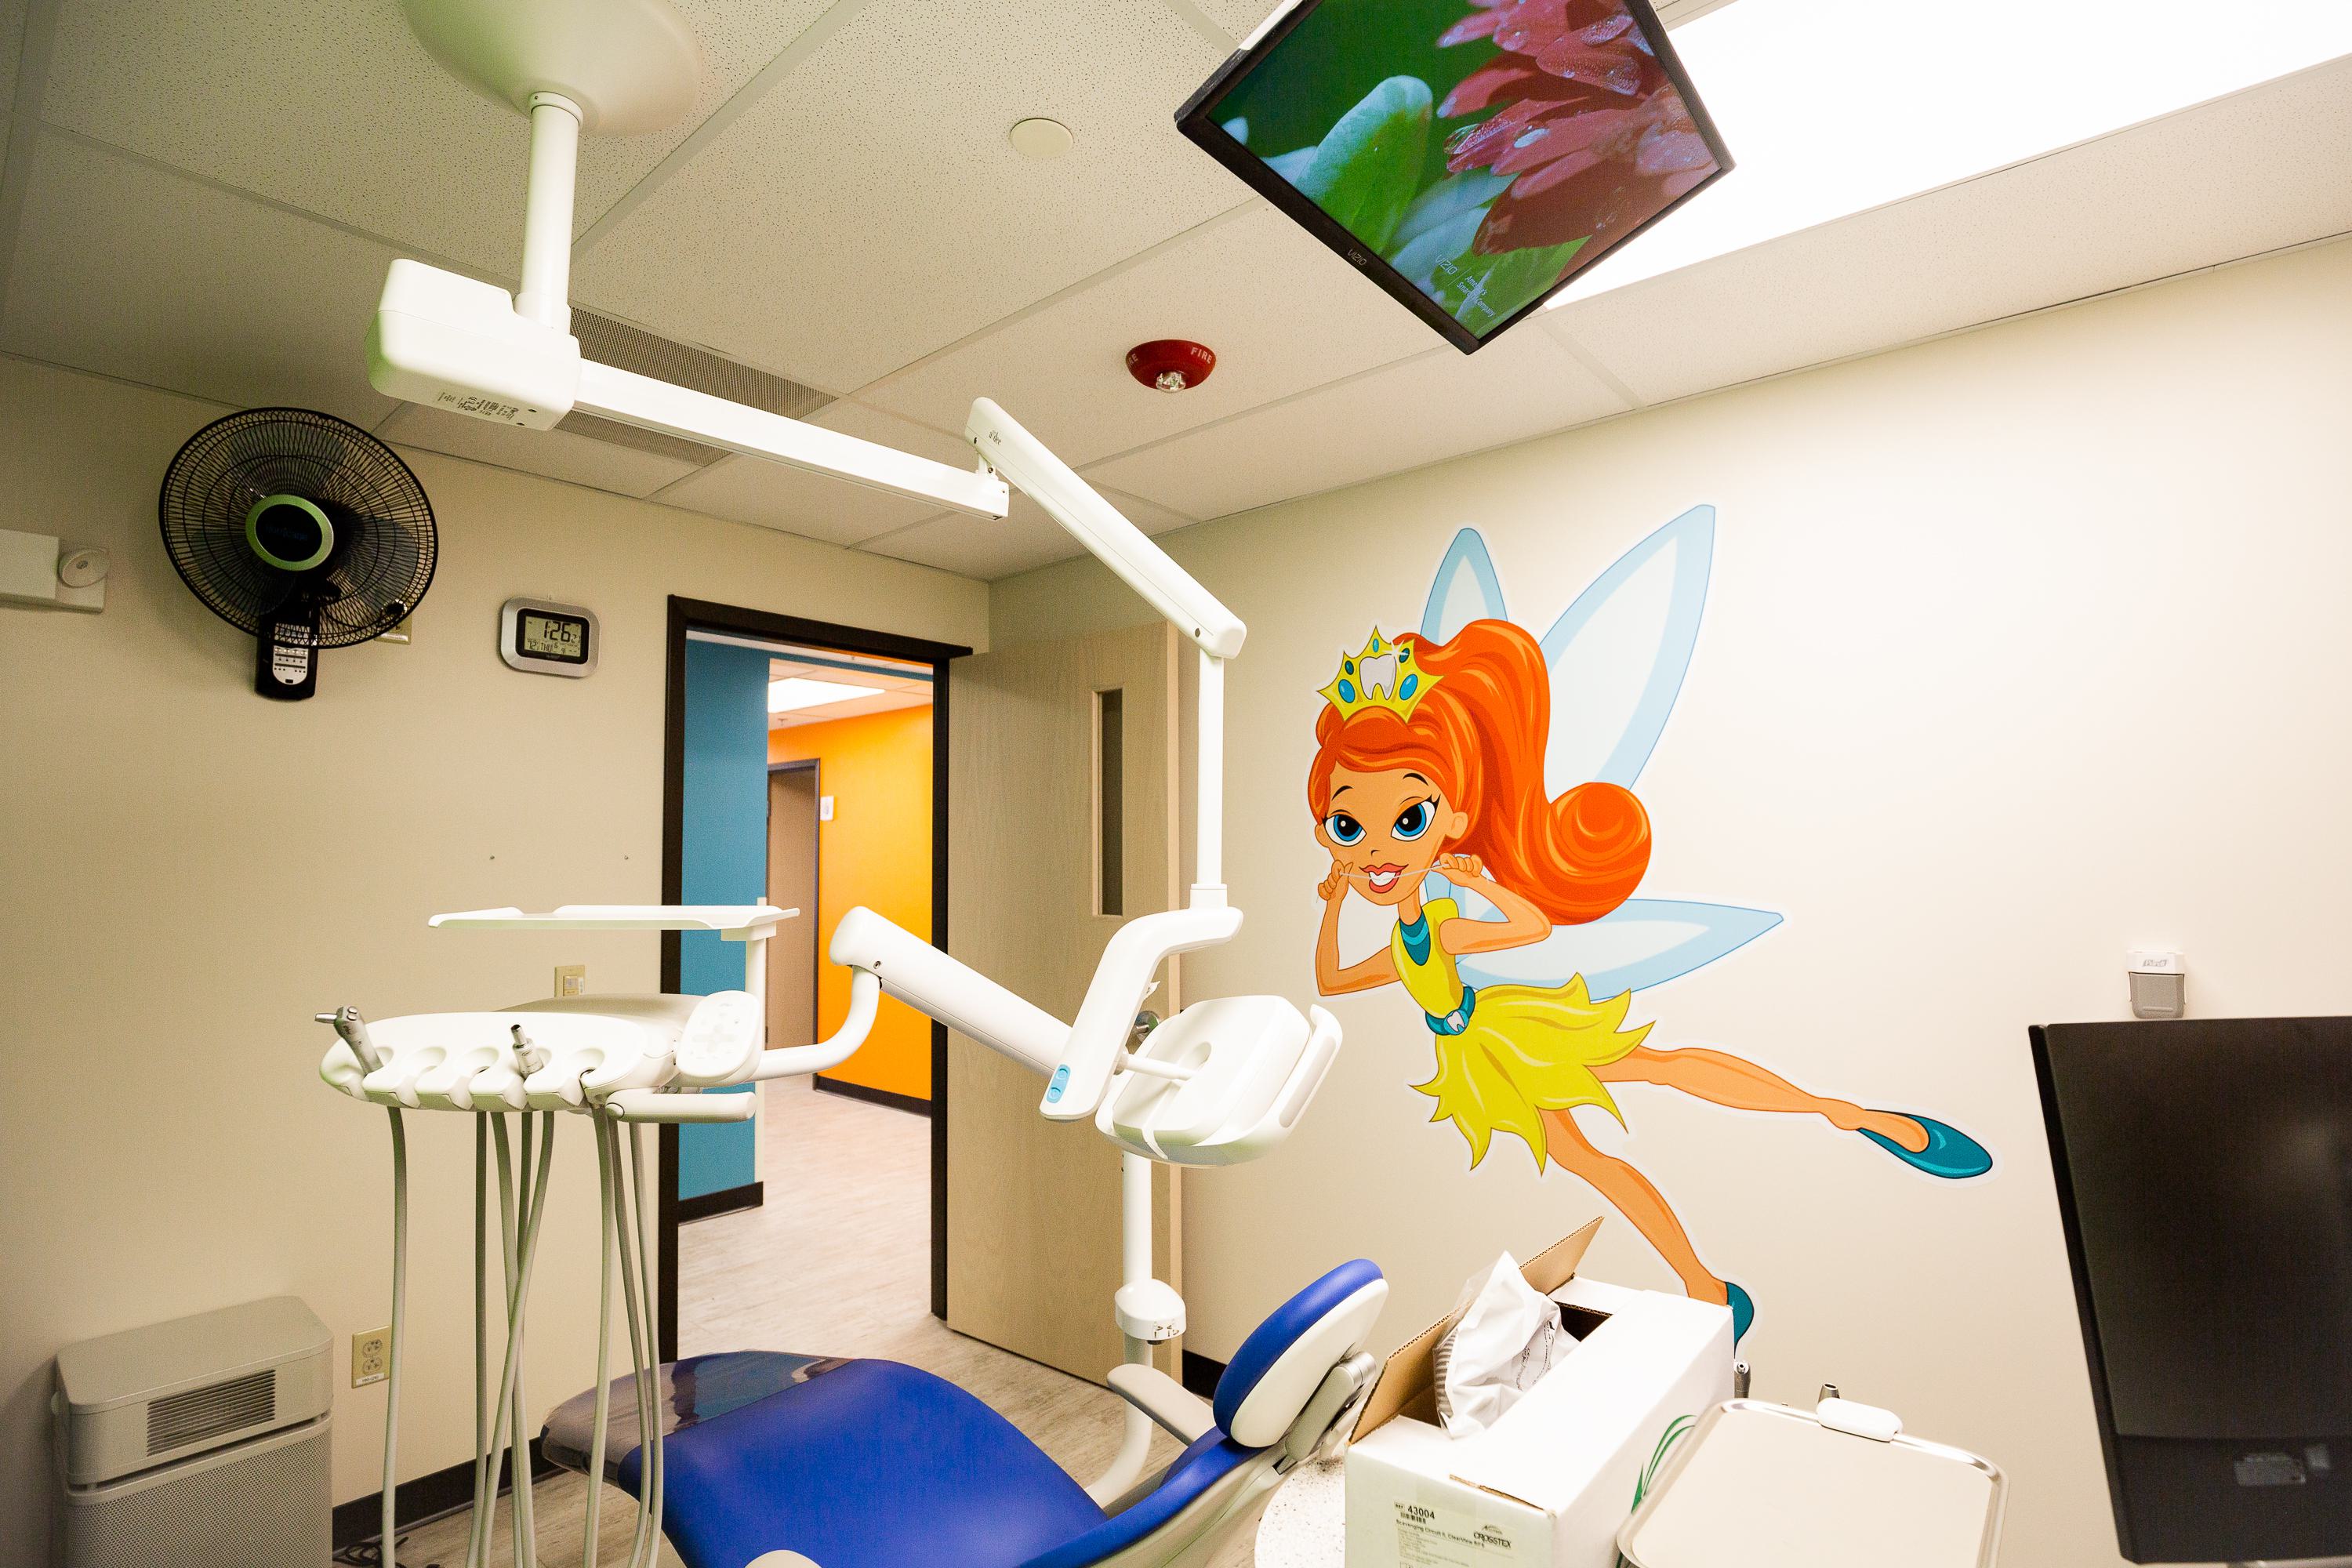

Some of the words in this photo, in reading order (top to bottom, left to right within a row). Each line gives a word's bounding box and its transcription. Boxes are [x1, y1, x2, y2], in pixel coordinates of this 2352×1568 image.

[1348, 248, 1367, 266] VIZIO
[1435, 254, 1458, 275] VIZIO
[1474, 297, 1496, 318] Company
[1190, 347, 1213, 364] FIRE
[1407, 1505, 1436, 1519] 43004
[1473, 1531, 1512, 1548] CROSSTEX
